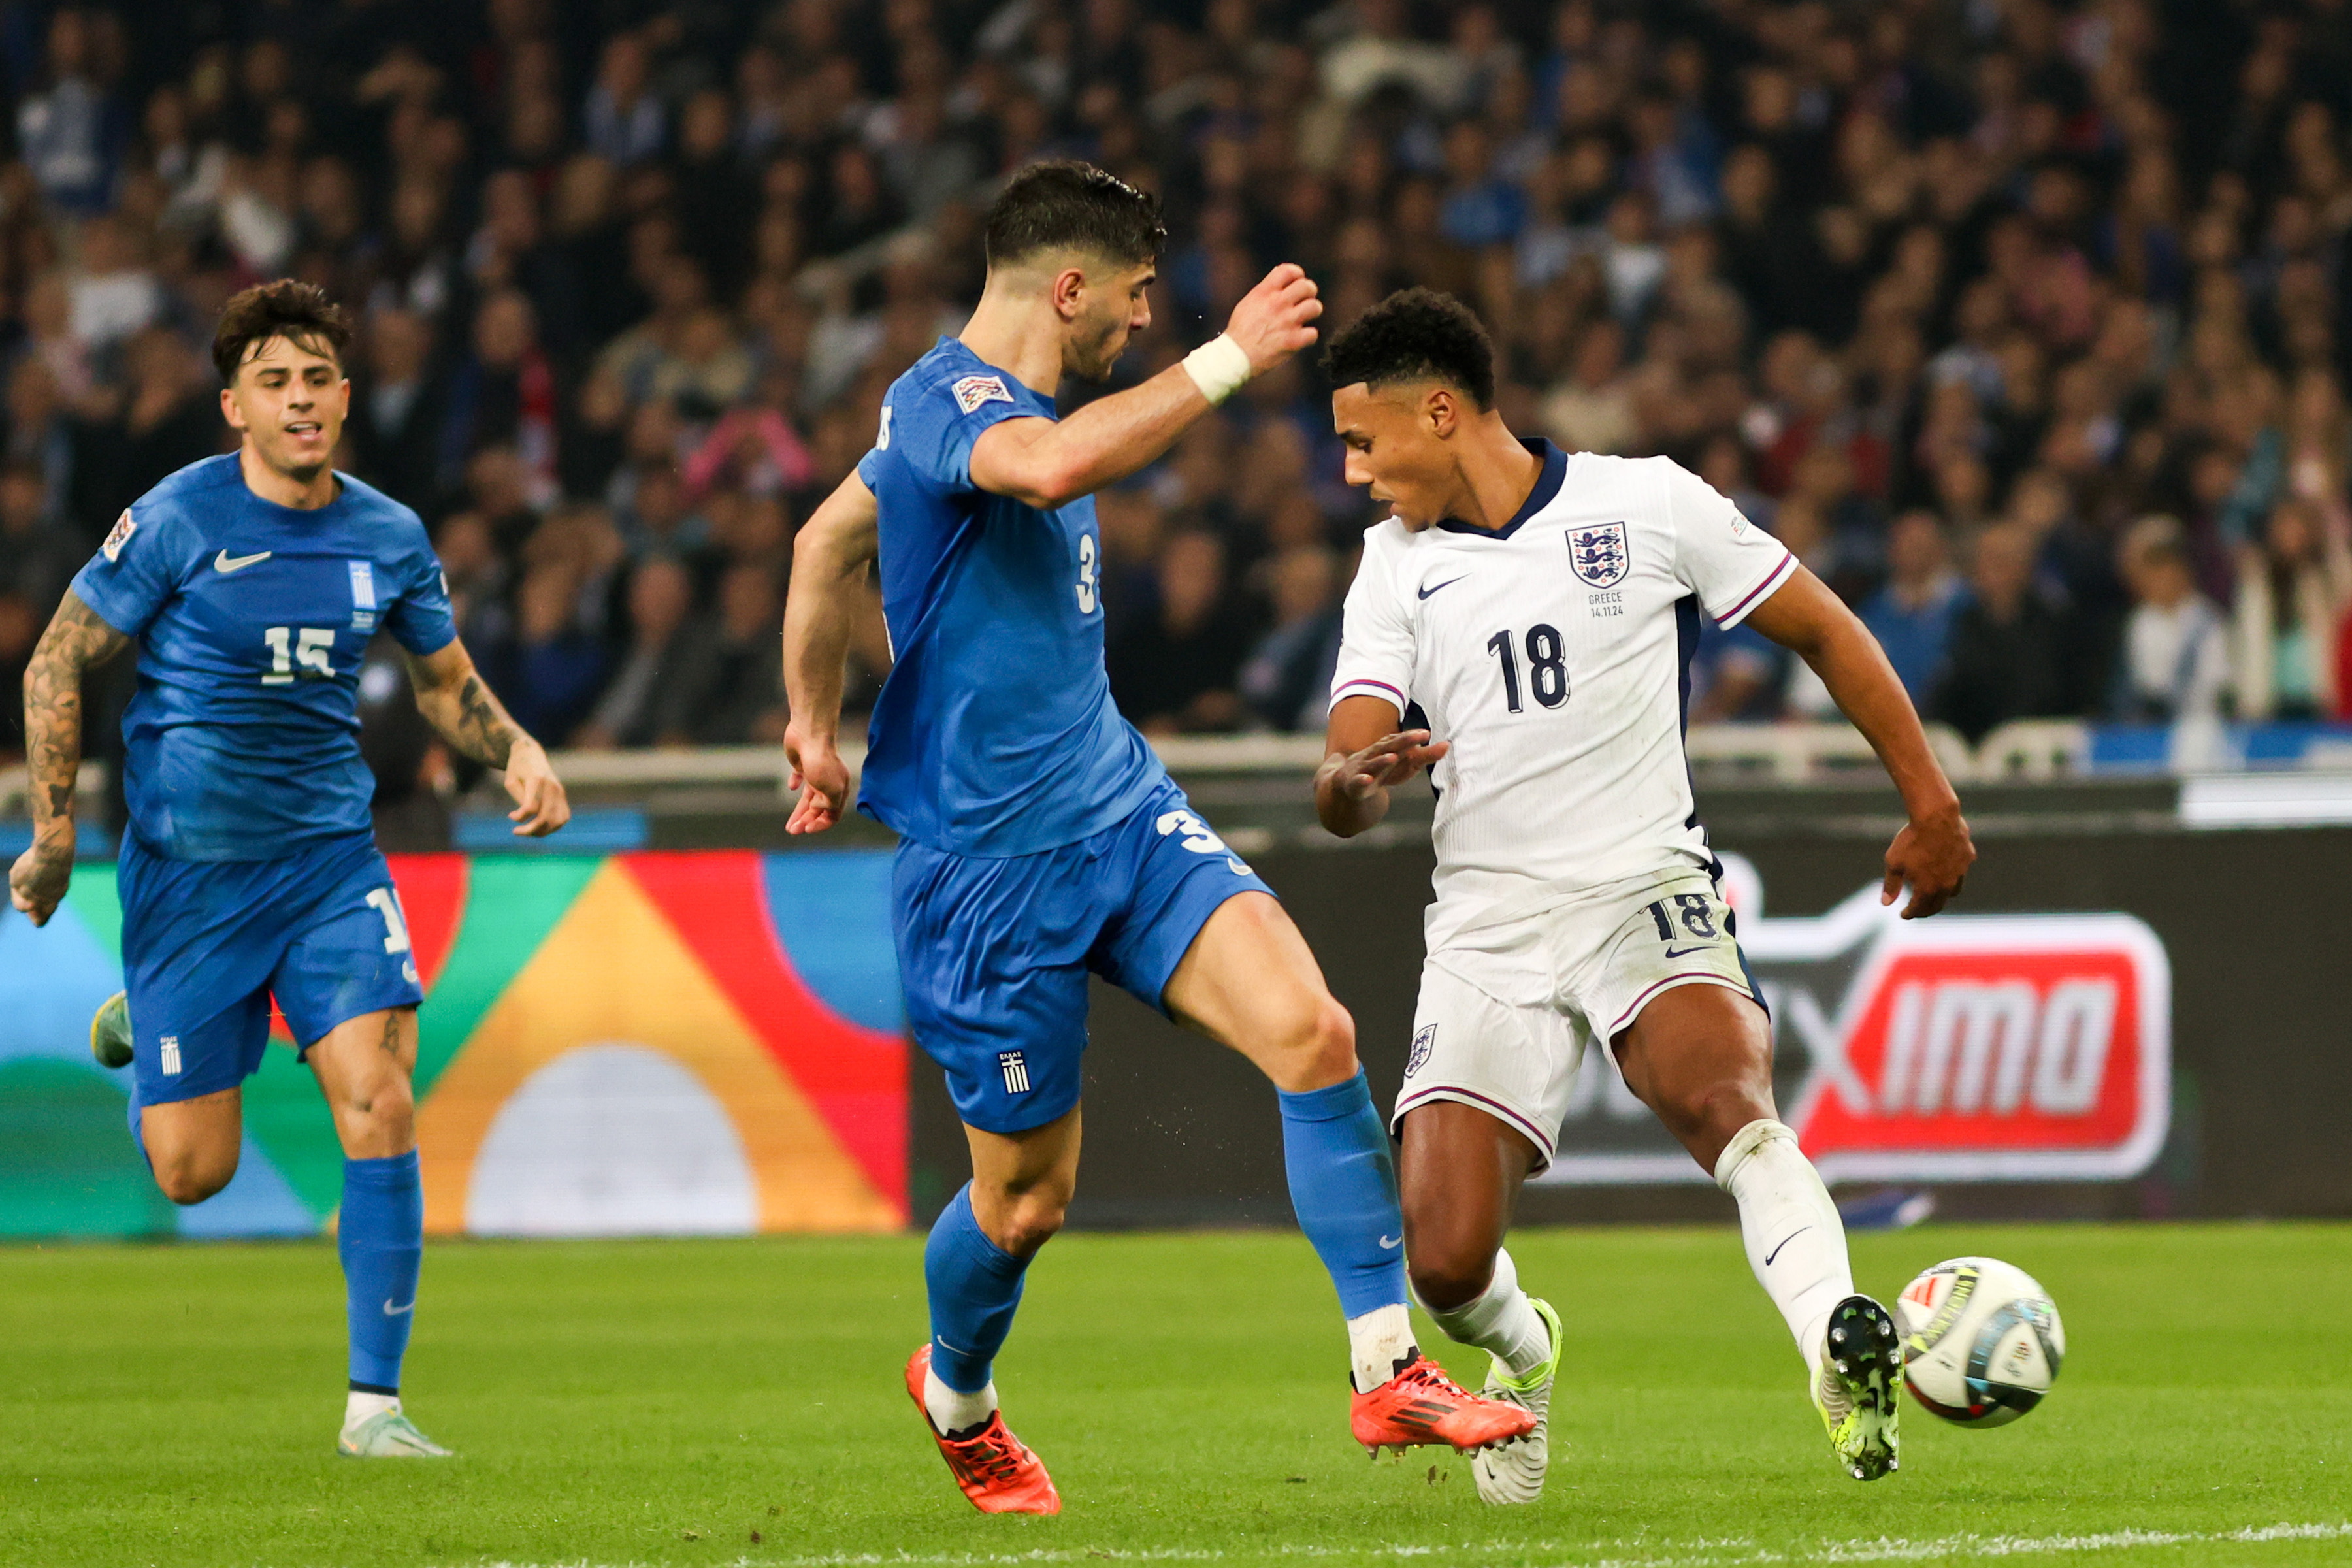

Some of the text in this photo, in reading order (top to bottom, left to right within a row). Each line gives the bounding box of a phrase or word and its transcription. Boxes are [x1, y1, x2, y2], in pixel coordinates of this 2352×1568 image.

[1075, 534, 1095, 614] 3
[1588, 591, 1622, 604] GREECE
[1591, 605, 1624, 618] 14.11.24
[261, 627, 336, 686] 15
[1487, 623, 1571, 713] 18
[1156, 809, 1226, 853] 3
[365, 887, 410, 954] 1
[1637, 894, 1722, 941] 18
